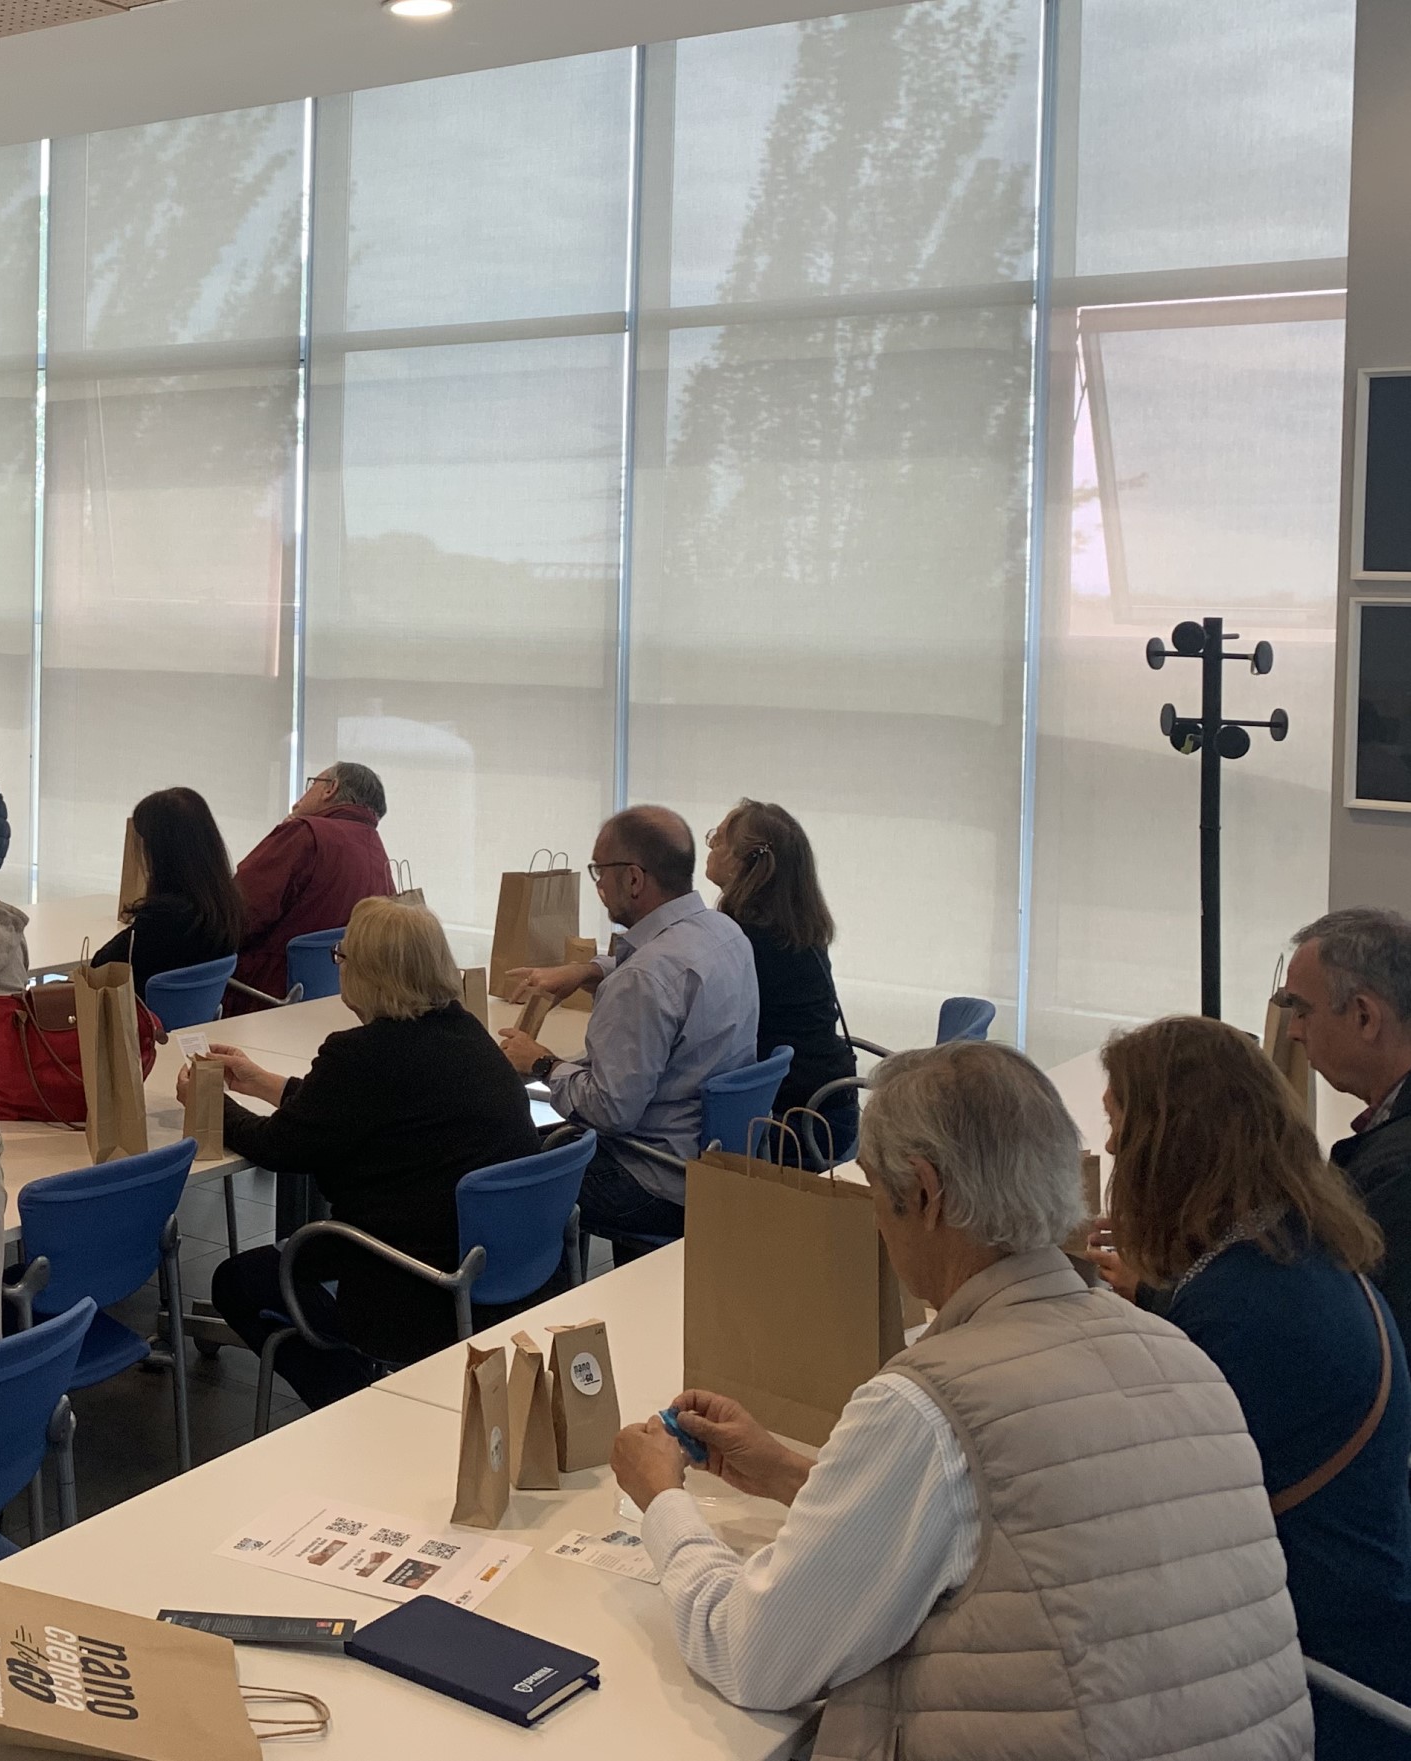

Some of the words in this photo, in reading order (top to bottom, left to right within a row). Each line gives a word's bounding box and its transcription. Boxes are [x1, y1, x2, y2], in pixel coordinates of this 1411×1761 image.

[5, 1657, 57, 1705] GO
[43, 1625, 86, 1712] ciencia
[77, 1635, 140, 1721] nano
